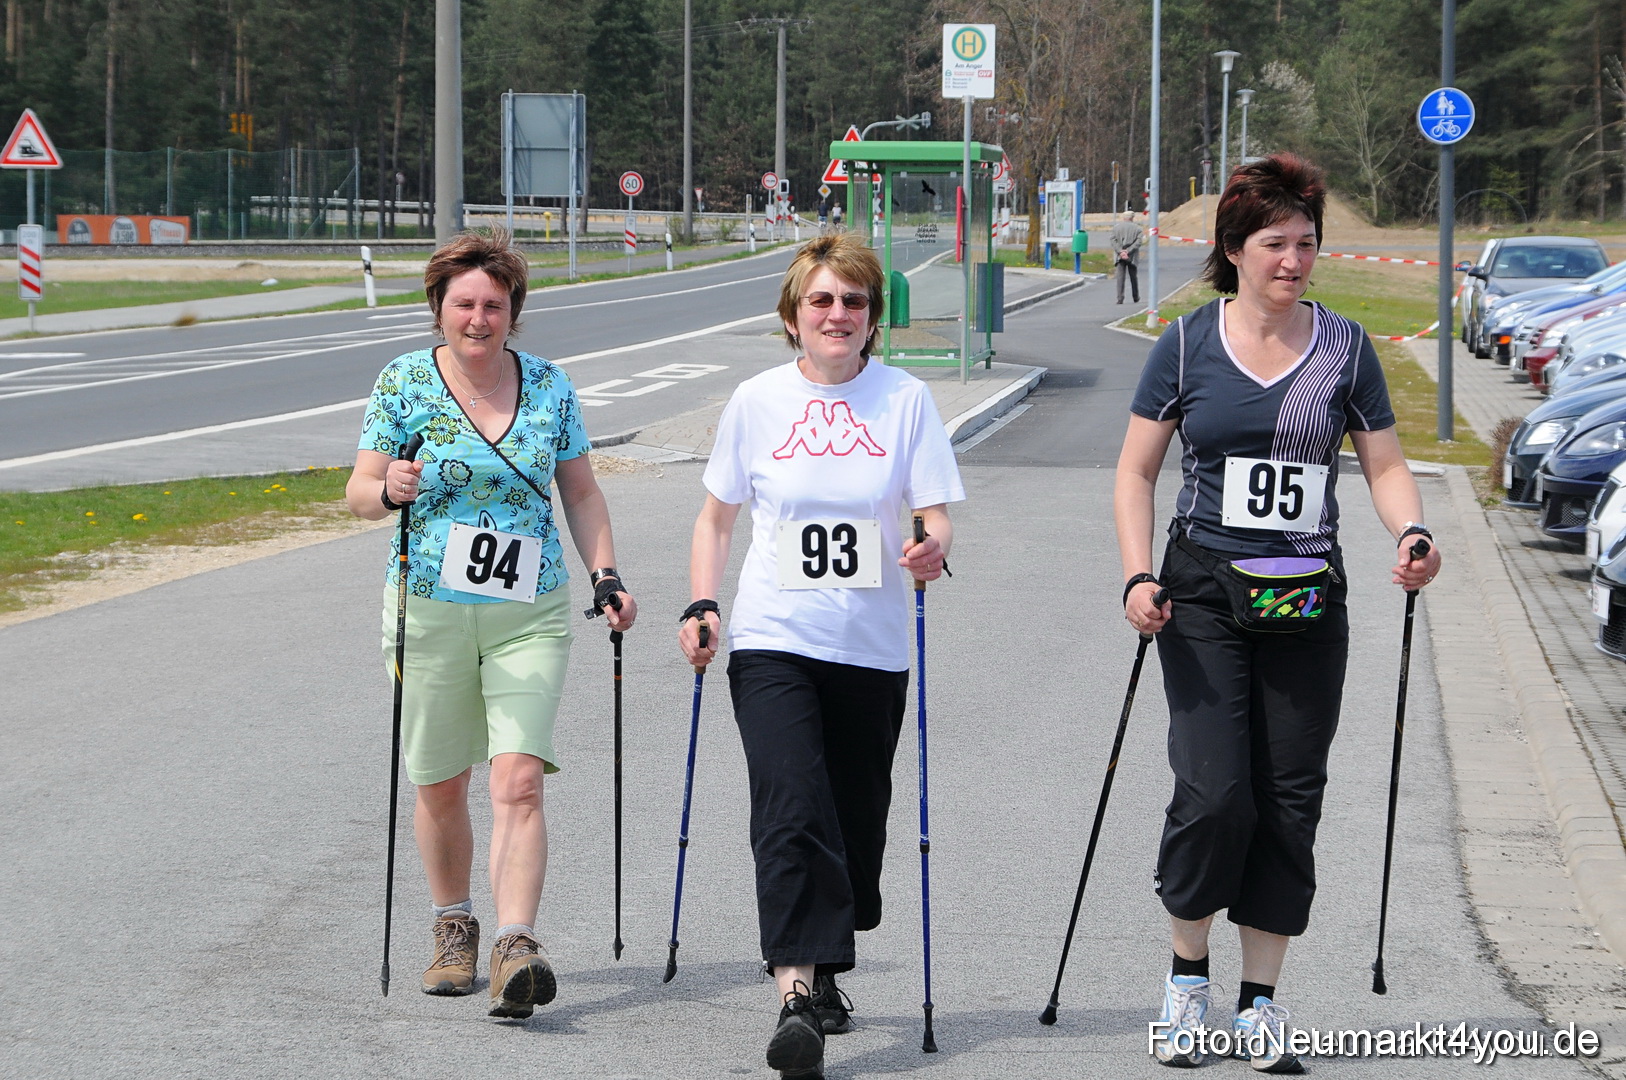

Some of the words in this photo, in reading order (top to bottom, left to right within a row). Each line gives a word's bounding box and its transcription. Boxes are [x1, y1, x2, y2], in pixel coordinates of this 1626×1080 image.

[962, 33, 976, 54] H
[625, 178, 637, 189] 60
[1247, 462, 1304, 521] 95
[466, 532, 522, 590] 94
[801, 523, 858, 579] 93
